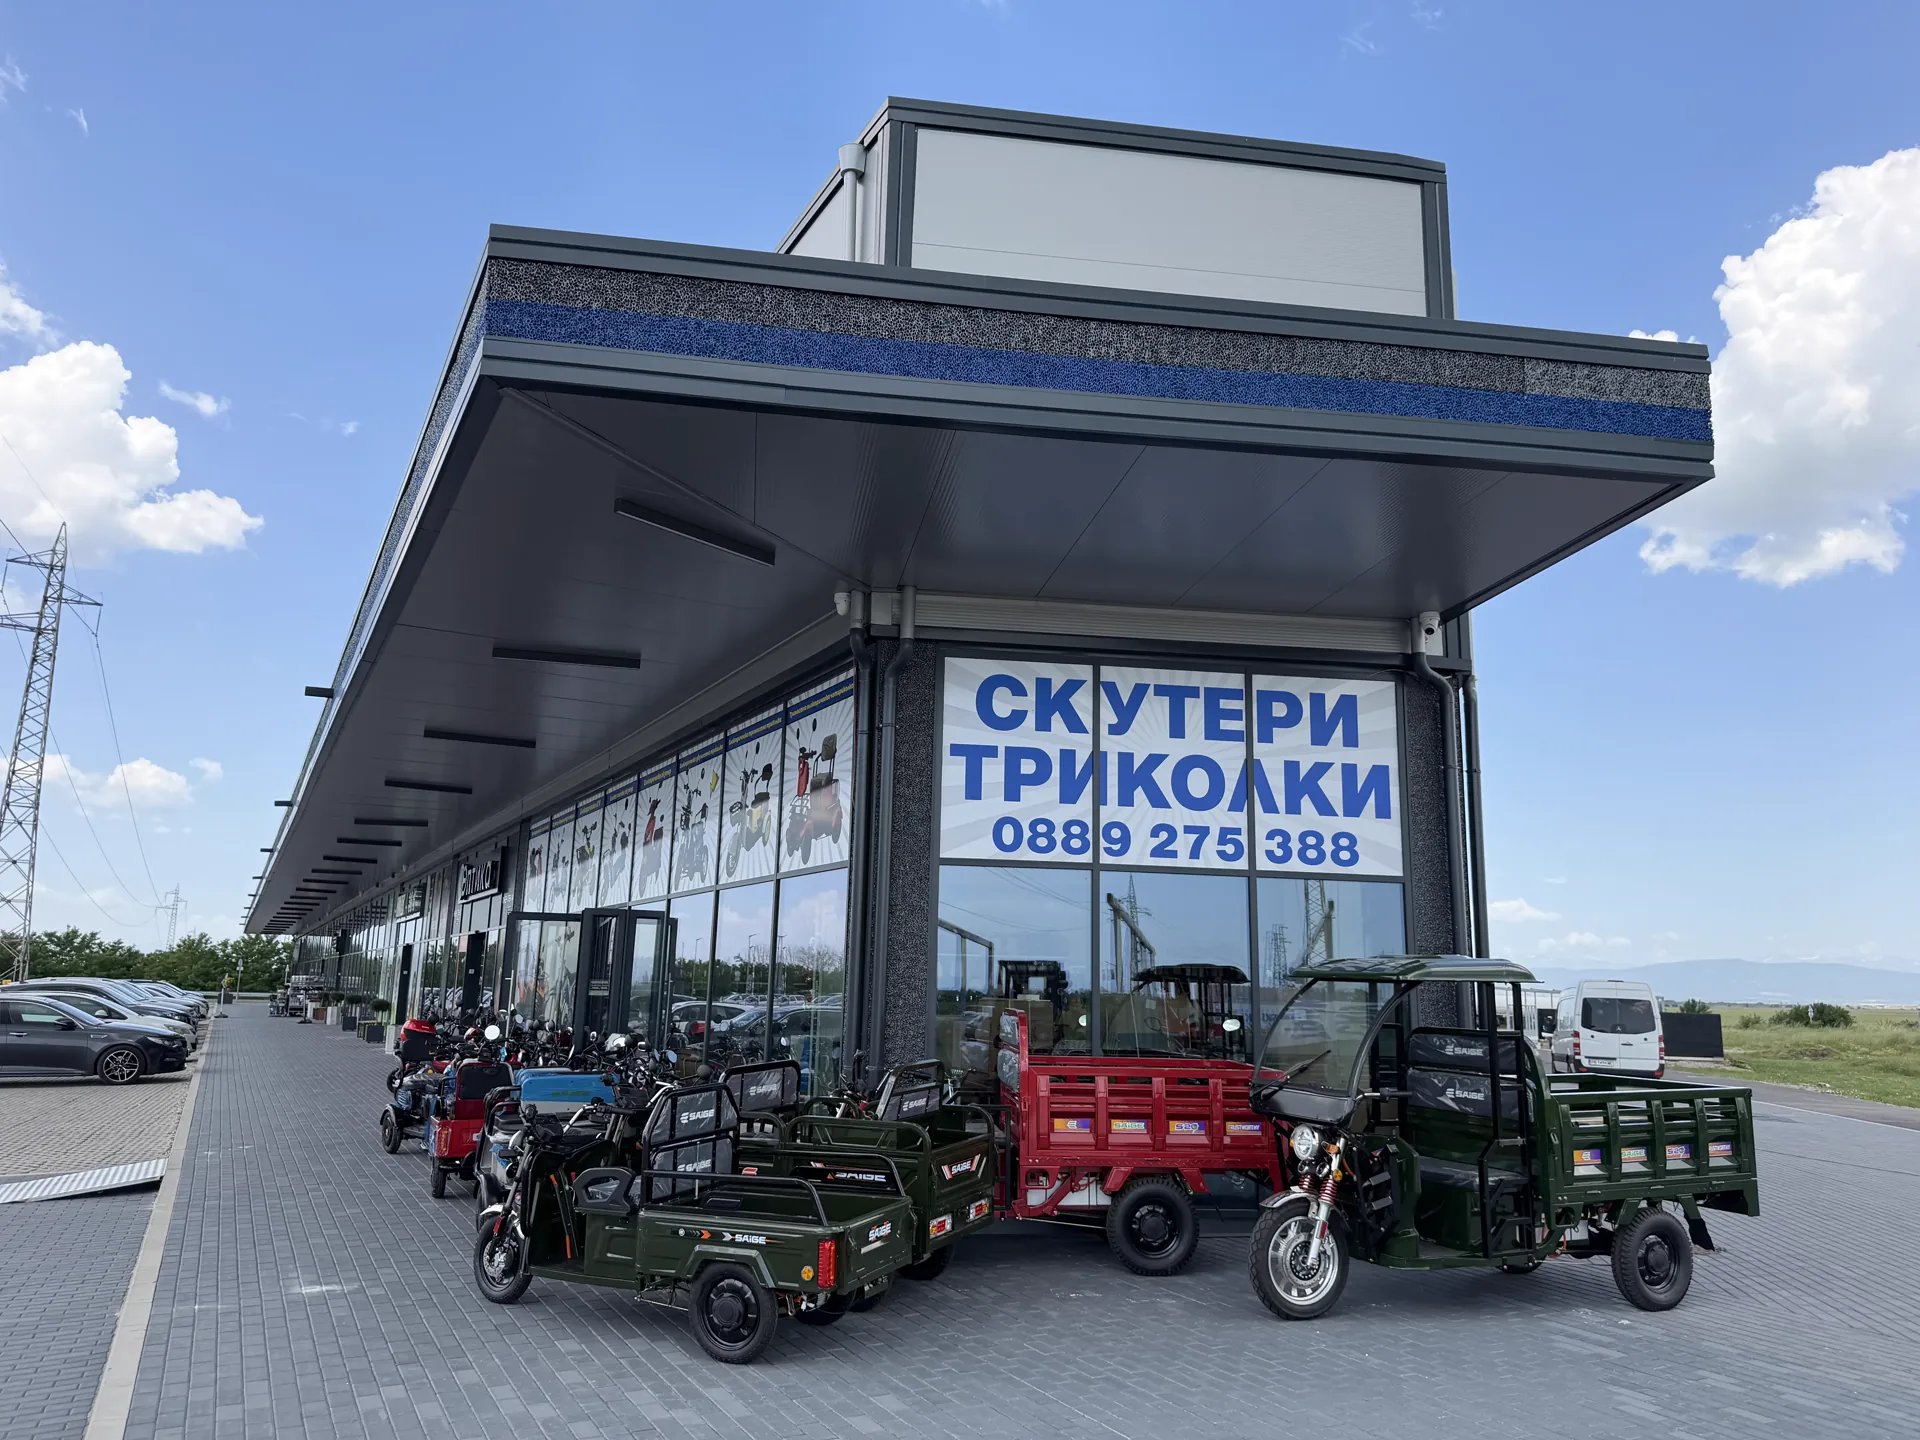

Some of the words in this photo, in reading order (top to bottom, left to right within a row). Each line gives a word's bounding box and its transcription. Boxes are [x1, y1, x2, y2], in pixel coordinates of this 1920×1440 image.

[975, 673, 1359, 748] СКУТЕРИ
[949, 743, 1391, 819] ТРИКОЛКИ
[992, 816, 1132, 857] 0889
[1149, 822, 1246, 863] 275
[1264, 828, 1360, 867] 388
